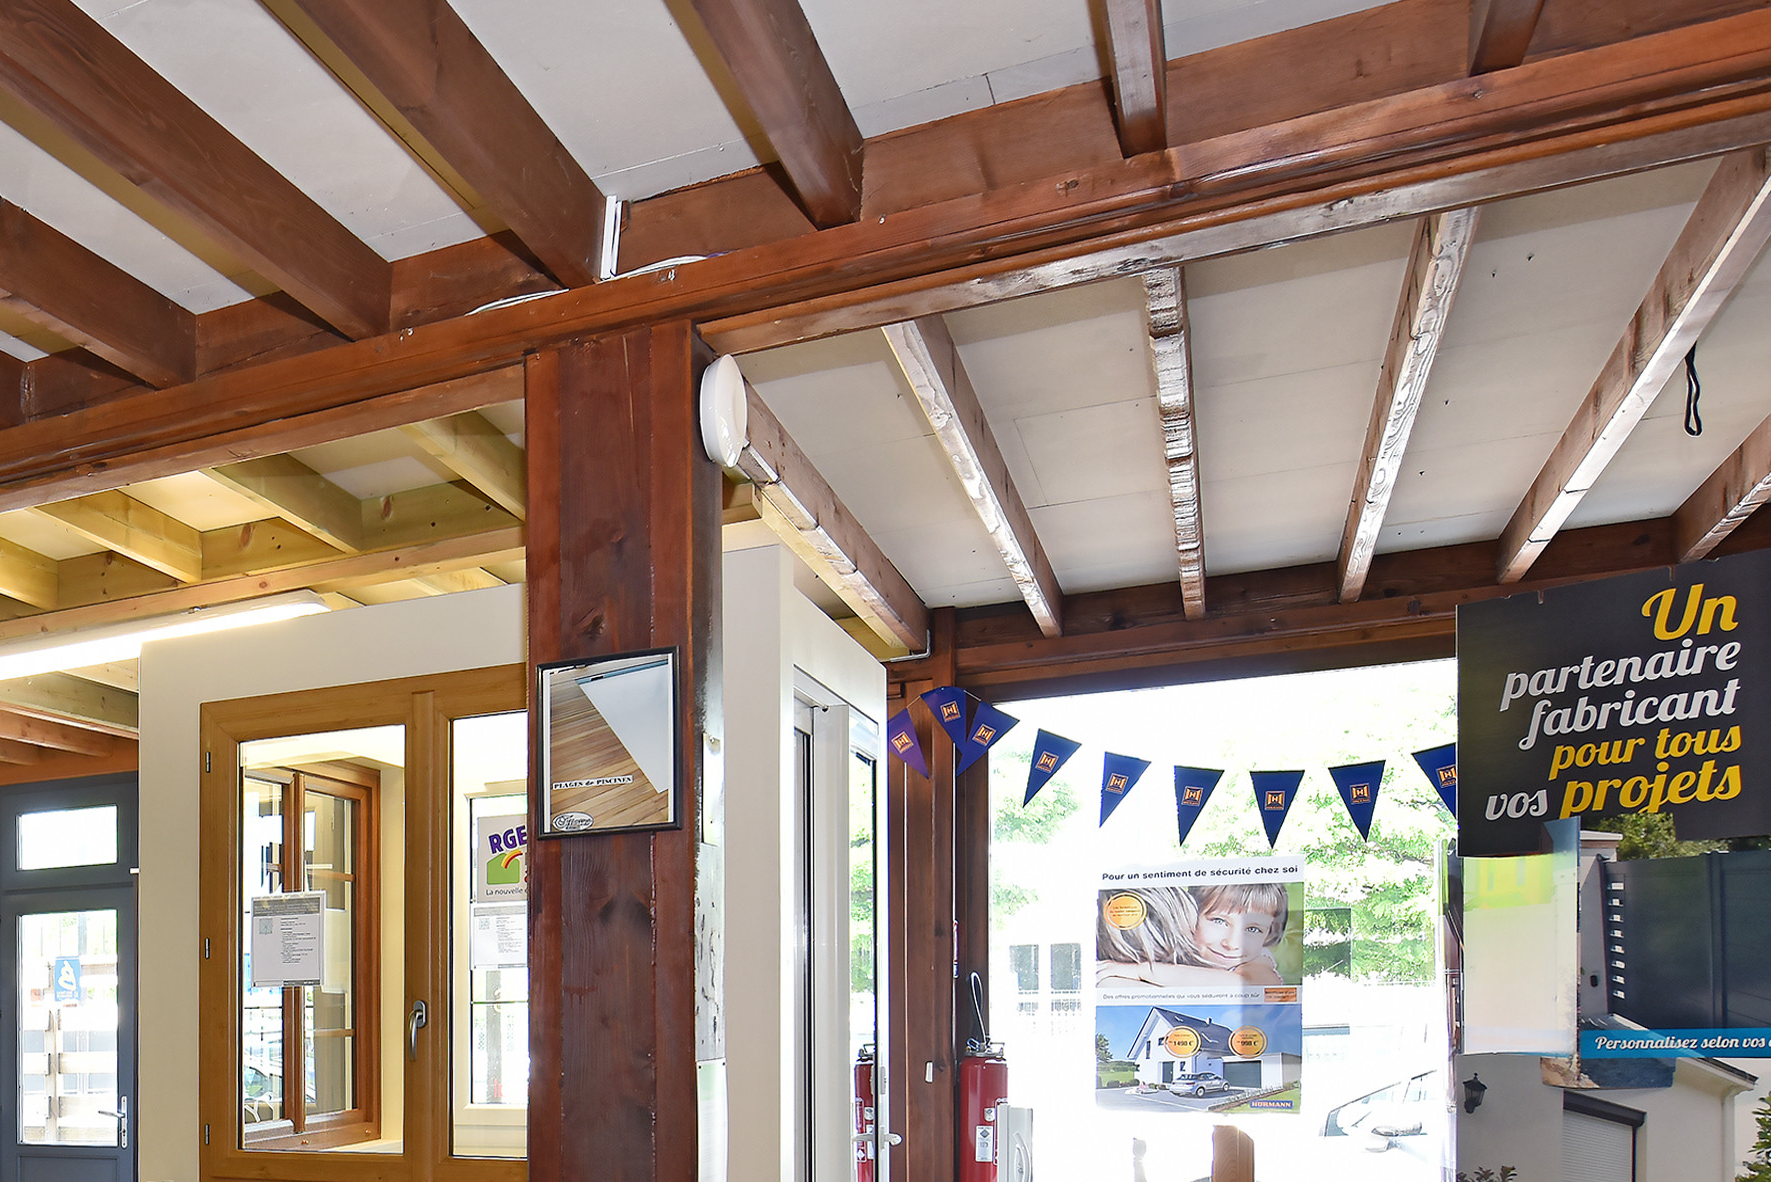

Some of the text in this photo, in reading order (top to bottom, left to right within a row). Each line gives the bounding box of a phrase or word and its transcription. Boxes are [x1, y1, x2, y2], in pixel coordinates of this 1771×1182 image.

[1642, 583, 1739, 641] Un
[1500, 638, 1741, 711] partenaire
[1518, 679, 1741, 750] fabricant
[1548, 725, 1742, 781] pour tous
[1485, 759, 1742, 821] vos projets
[488, 825, 528, 854] RGE
[494, 887, 523, 895] nouvelle
[1102, 873, 1125, 881] Pour
[1142, 870, 1192, 879] sentiment
[1195, 869, 1207, 877] de
[1210, 867, 1251, 876] sécurité
[1255, 866, 1279, 874] chez
[1282, 865, 1298, 873] soi
[1595, 1036, 1698, 1050] Personnalisez
[1701, 1035, 1740, 1049] selon
[1742, 1037, 1766, 1048] vos
